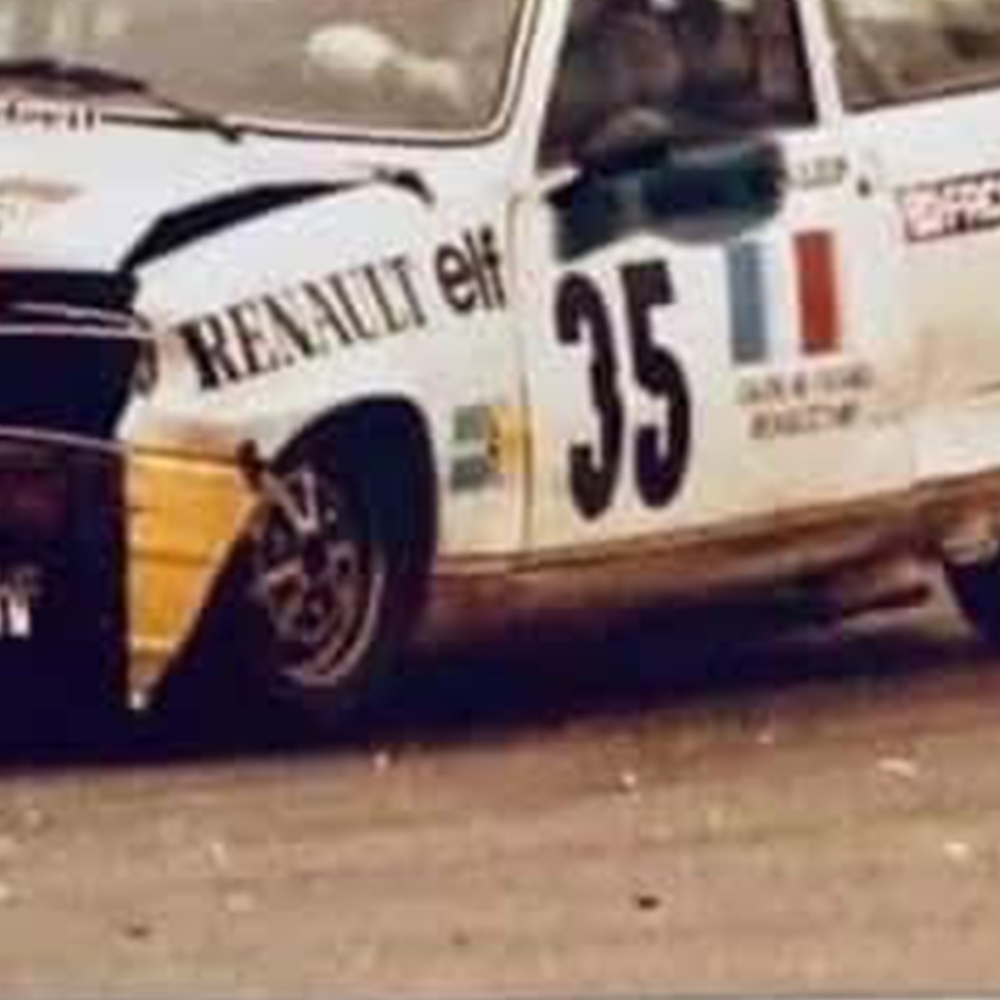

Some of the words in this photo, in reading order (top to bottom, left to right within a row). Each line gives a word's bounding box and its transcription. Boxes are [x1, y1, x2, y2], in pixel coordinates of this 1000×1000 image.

[178, 252, 427, 392] RENAULT
[435, 224, 506, 314] elf
[554, 258, 692, 520] 35
